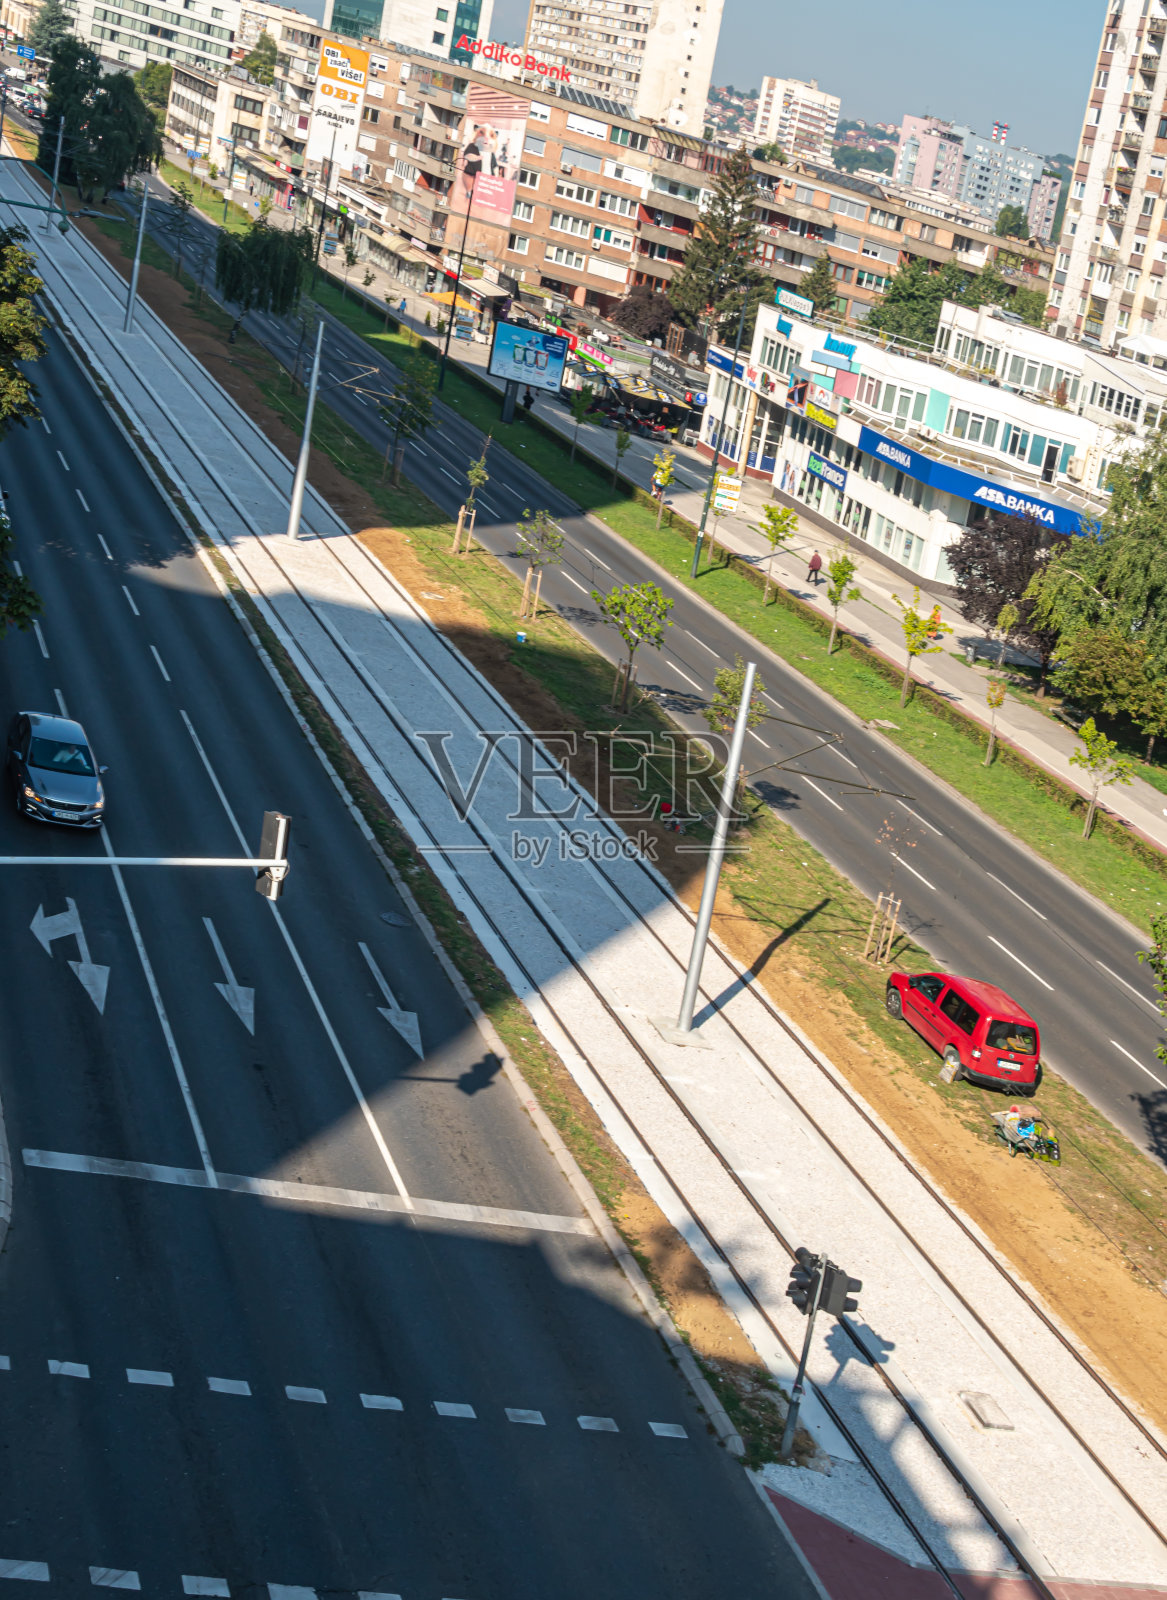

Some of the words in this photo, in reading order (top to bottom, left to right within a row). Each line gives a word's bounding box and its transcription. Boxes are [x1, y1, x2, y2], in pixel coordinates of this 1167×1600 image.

[325, 48, 339, 58] OBI
[455, 34, 522, 68] Addiko
[523, 54, 572, 83] Bank
[341, 69, 363, 82] više!
[320, 83, 360, 105] OBI
[316, 108, 356, 126] SARAJEVO
